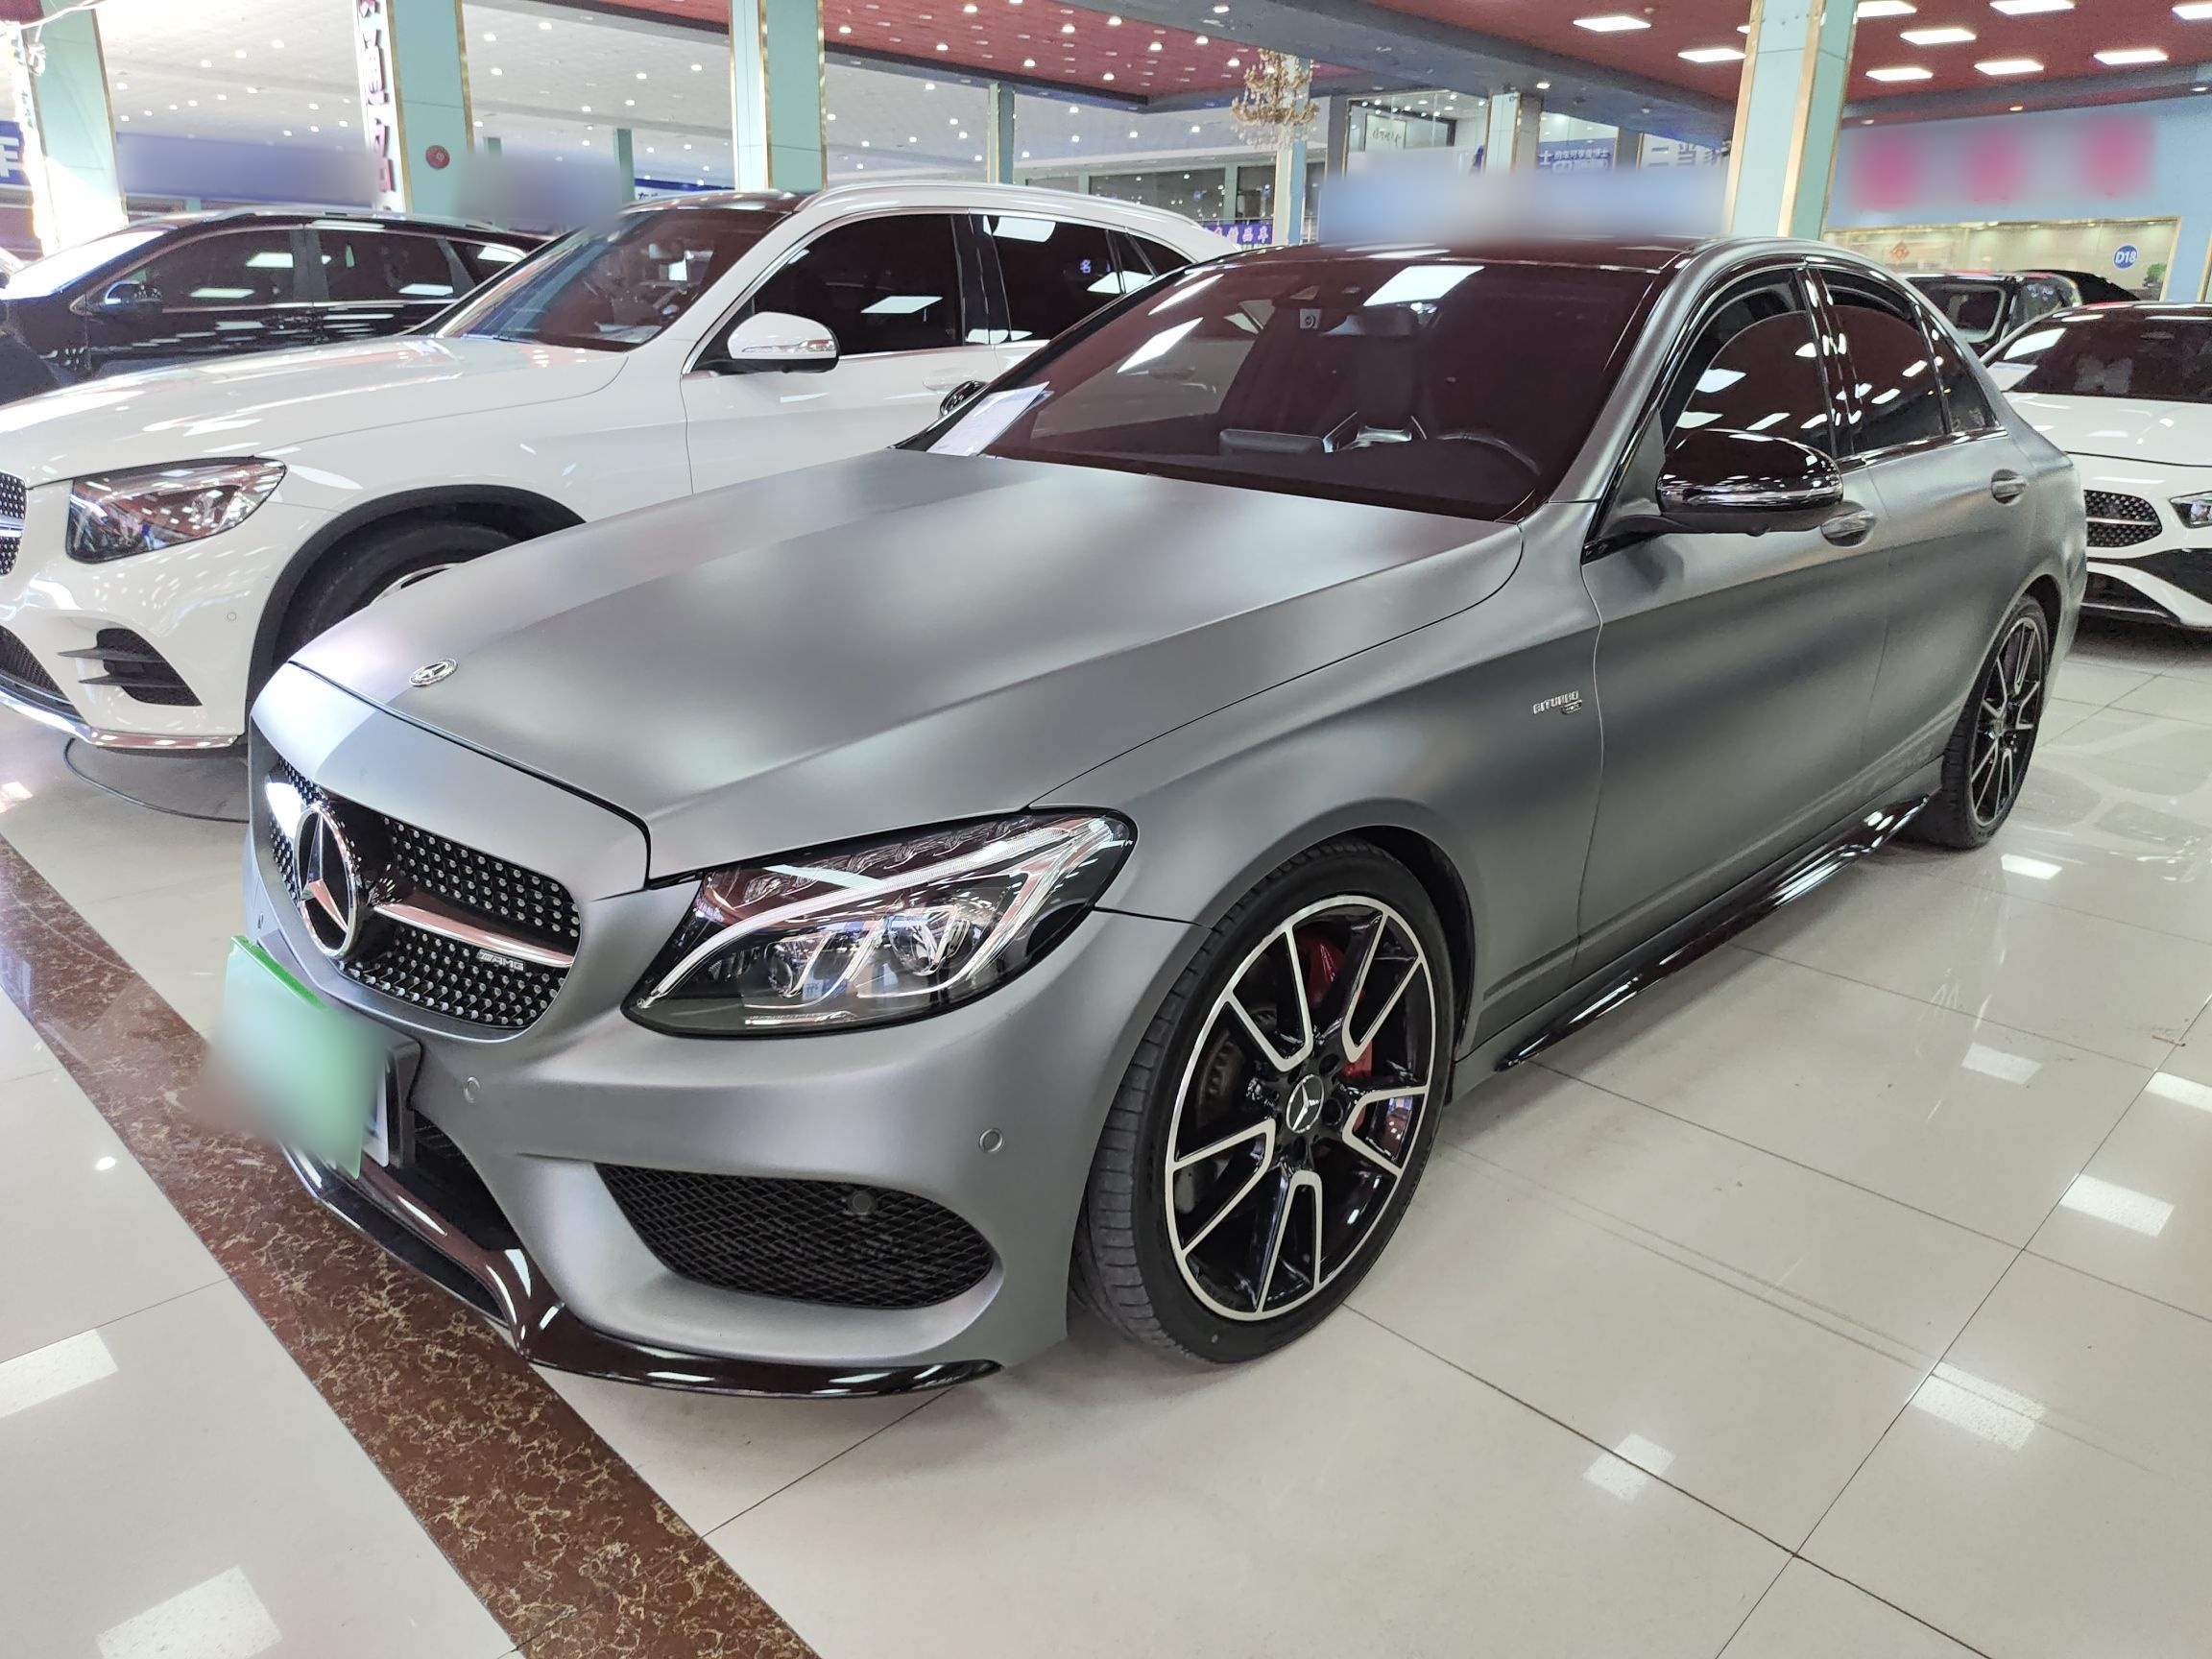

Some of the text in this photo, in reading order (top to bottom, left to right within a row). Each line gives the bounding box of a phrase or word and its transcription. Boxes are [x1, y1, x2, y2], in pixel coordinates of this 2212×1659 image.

[2115, 251, 2137, 264] D18
[1532, 690, 1579, 715] BITURBO
[491, 954, 524, 972] AMG
